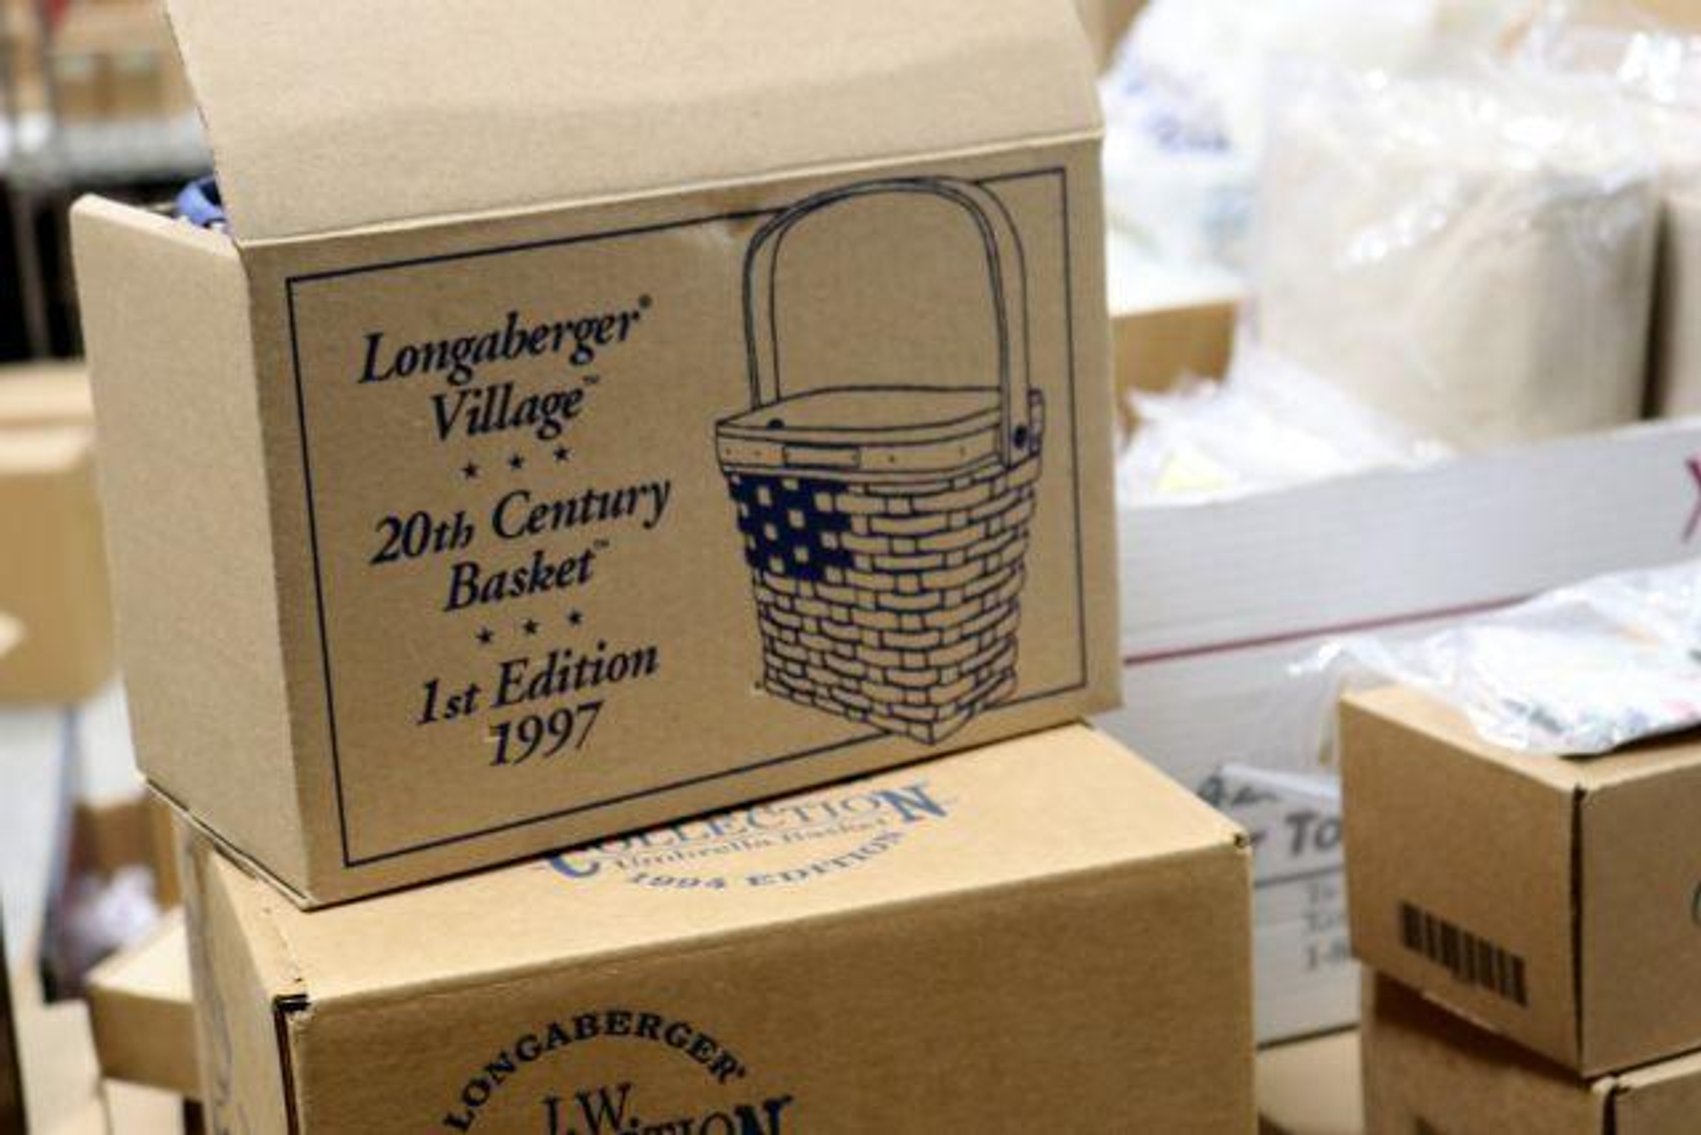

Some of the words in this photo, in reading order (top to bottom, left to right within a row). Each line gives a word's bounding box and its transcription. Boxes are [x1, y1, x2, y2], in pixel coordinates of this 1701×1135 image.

[357, 311, 641, 386] Longaberger
[430, 381, 585, 441] Village
[369, 510, 475, 567] 20th
[491, 480, 671, 539] Century
[443, 549, 597, 612] Basket
[416, 678, 482, 726] 1st
[490, 640, 659, 709] Edition
[488, 700, 605, 766] 1997
[746, 832, 904, 886] EDITION
[443, 1009, 742, 1133] LONGABERGER
